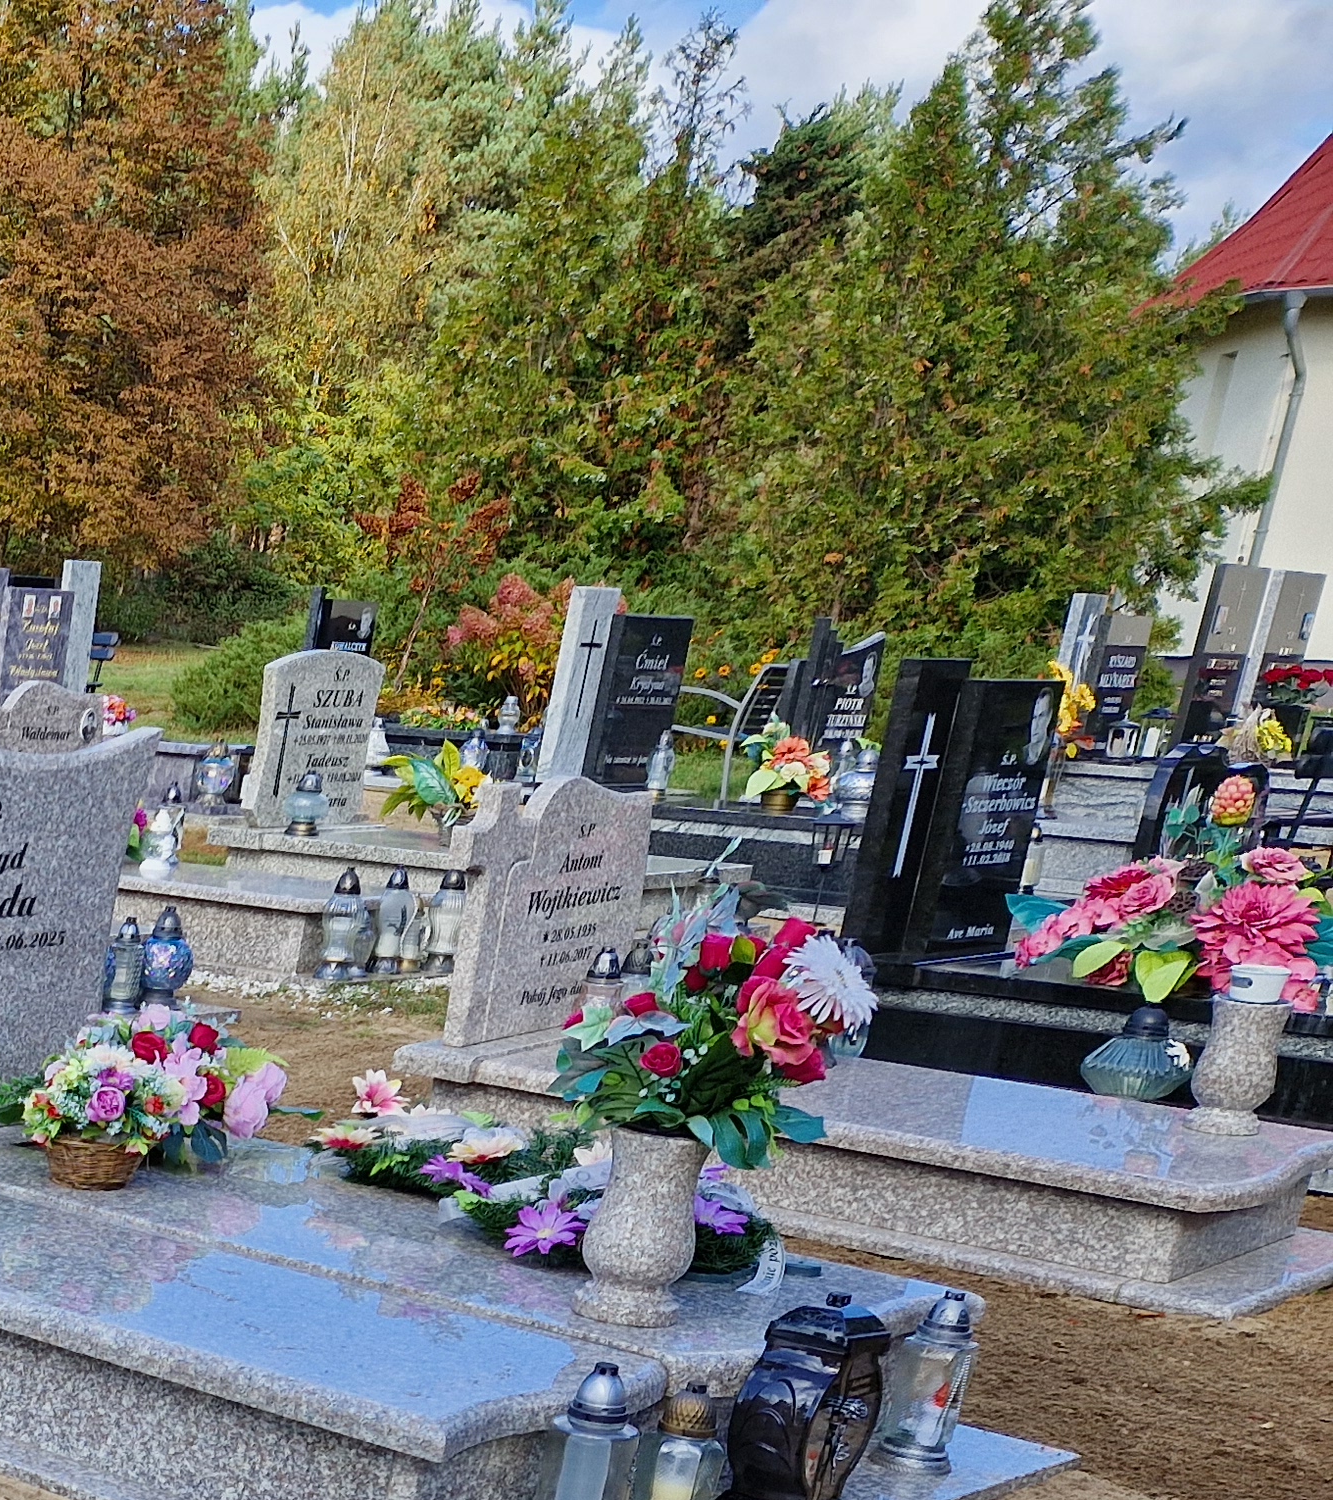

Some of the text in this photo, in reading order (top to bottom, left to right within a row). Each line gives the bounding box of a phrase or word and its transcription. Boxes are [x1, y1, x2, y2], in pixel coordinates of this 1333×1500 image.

[635, 648, 670, 670] Ćmiel
[333, 665, 349, 682] Ś.P.
[313, 689, 364, 708] SZUBA
[834, 697, 864, 711] PIOTR
[303, 714, 363, 731] Stanisława
[20, 726, 72, 742] Waldemar
[306, 752, 350, 768] Tadeusz
[1000, 750, 1018, 766] Ś.P.
[326, 792, 348, 808] aria
[978, 818, 1011, 838] Józef
[559, 850, 605, 874] Antoni
[527, 882, 623, 920] Wojtkiewicz
[946, 924, 994, 941] Ave Maria
[519, 984, 547, 1007] Pokój
[547, 984, 569, 1006] Jego
